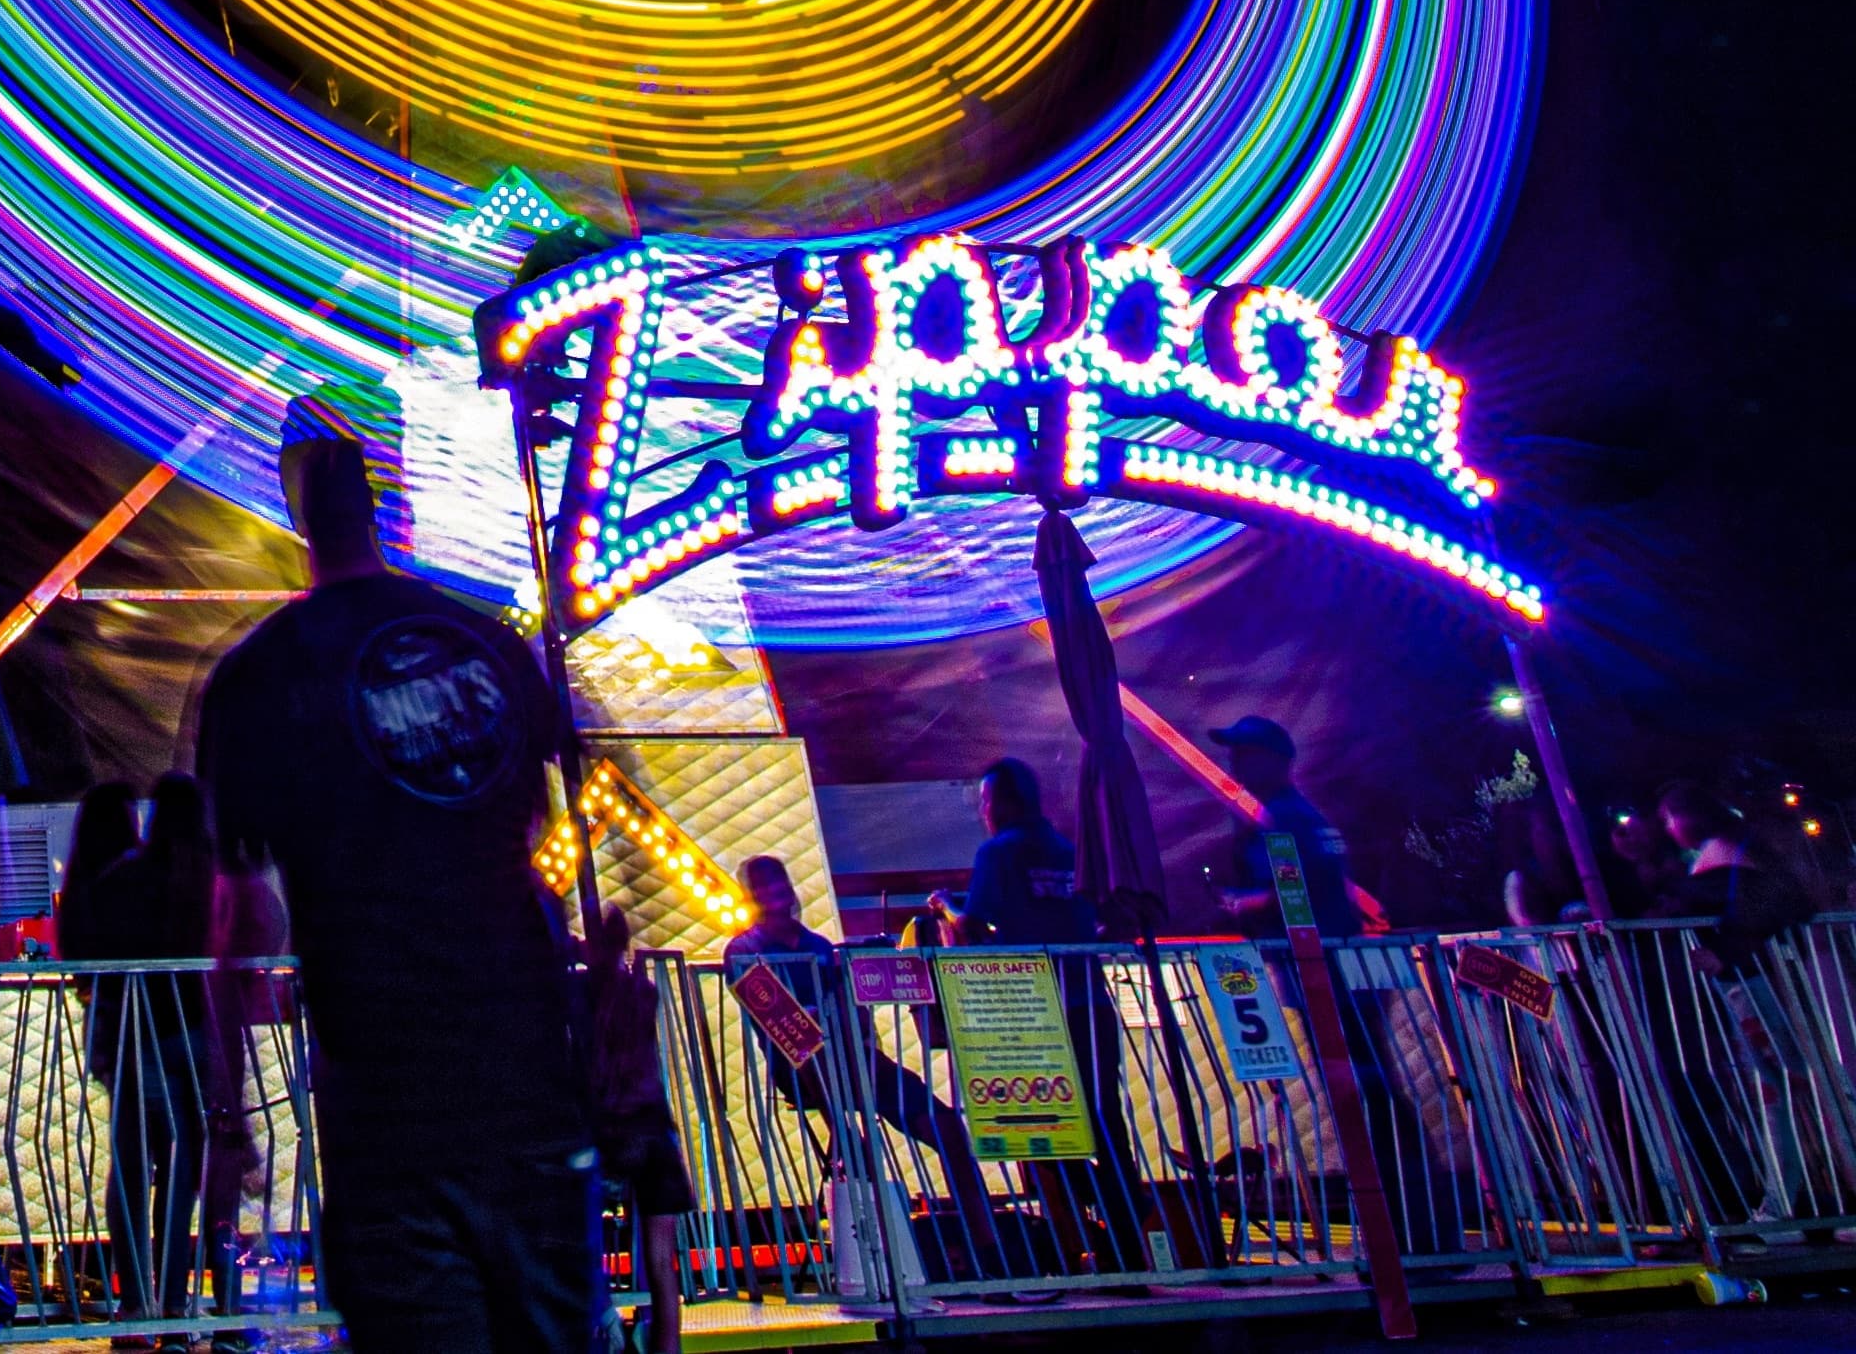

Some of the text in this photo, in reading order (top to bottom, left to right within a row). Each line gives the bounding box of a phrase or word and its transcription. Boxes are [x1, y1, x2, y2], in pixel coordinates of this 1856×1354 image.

[476, 232, 1546, 631] Zipper
[896, 960, 912, 970] DO
[942, 961, 1047, 975] FOR YOUR SAFETY
[860, 973, 882, 987] STOP
[895, 974, 917, 984] NOT
[780, 1015, 805, 1042] NOT
[792, 1010, 810, 1030] DO
[1233, 997, 1270, 1046] 5
[765, 1017, 801, 1060] ENTER
[1233, 1046, 1290, 1065] TICKETS
